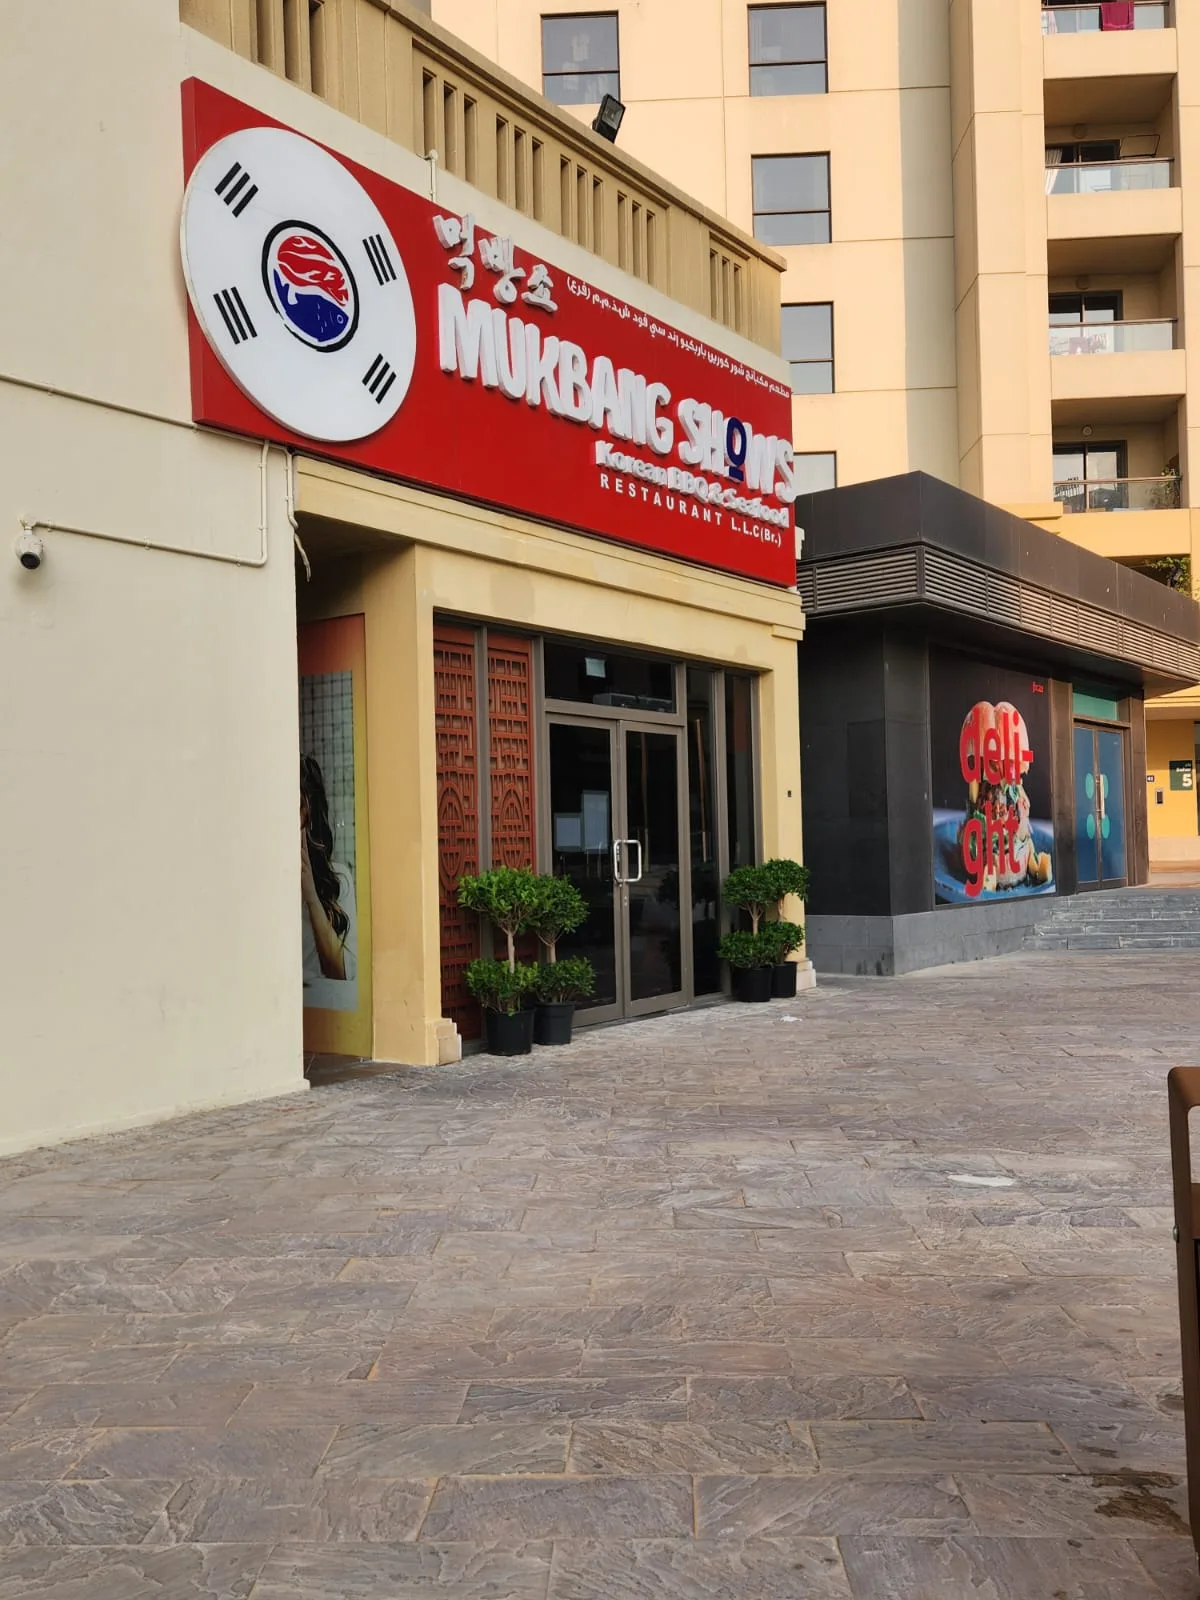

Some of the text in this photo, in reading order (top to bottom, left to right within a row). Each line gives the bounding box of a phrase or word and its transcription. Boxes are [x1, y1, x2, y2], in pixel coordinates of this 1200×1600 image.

[566, 275, 591, 300] (فرع)
[632, 313, 649, 328] فود
[649, 323, 666, 338] سي
[437, 282, 796, 504] MUKBANG SHOWS
[768, 383, 790, 399] مطعم
[594, 440, 668, 487] Korean
[667, 466, 709, 504] BBQ
[722, 487, 790, 529] Seafood
[600, 473, 783, 548] RESTAURANT L.L.C(Br.)
[959, 706, 1034, 785] deli-
[1182, 773, 1193, 787] 5
[962, 800, 1021, 898] ght
